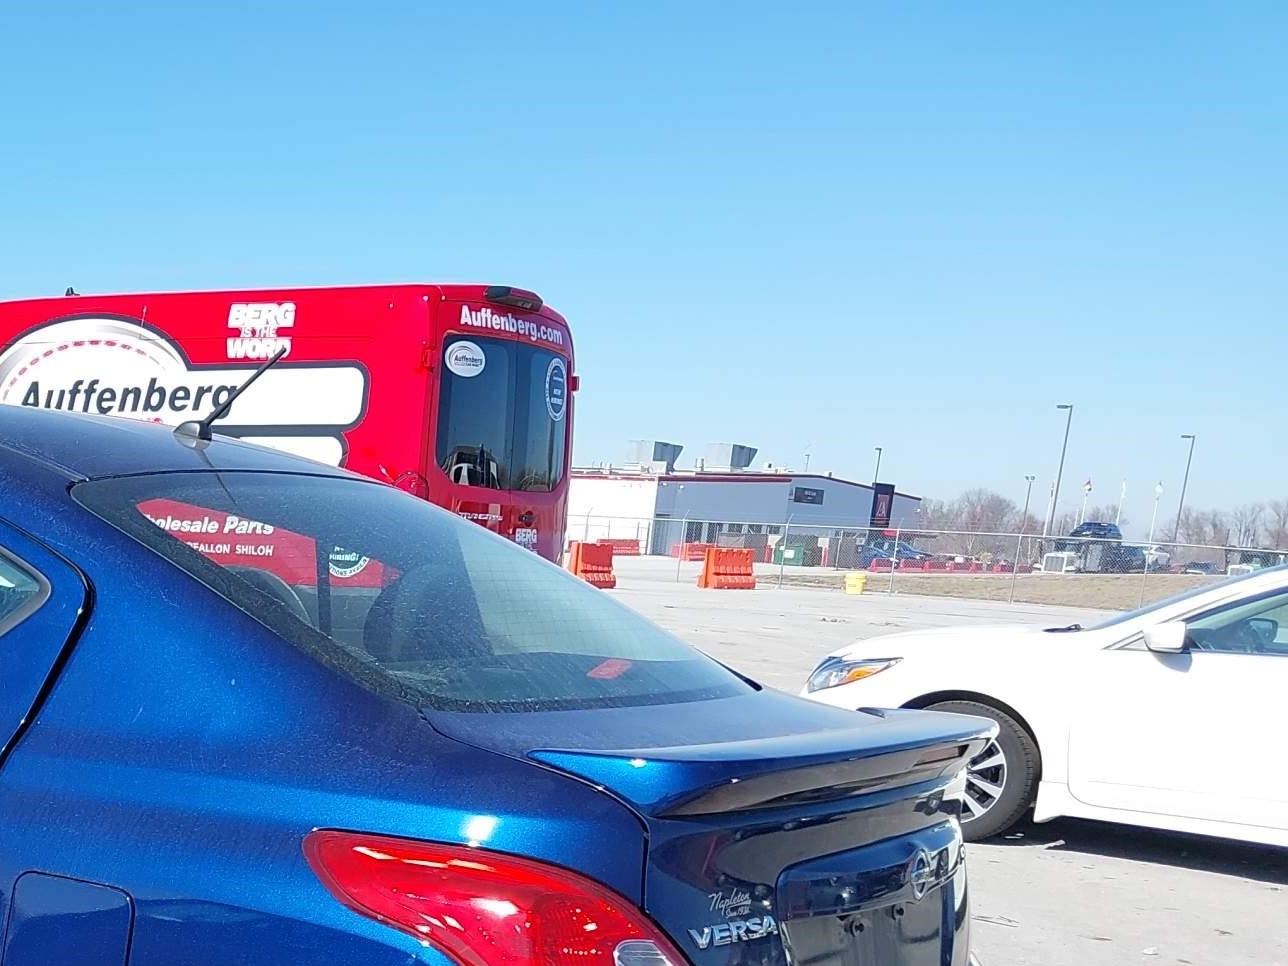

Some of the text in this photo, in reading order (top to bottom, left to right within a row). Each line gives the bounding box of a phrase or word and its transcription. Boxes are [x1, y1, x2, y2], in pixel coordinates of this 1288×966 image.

[228, 303, 296, 328] BERG
[460, 305, 563, 345] Auffenberg.com
[240, 327, 277, 338] IS THE
[227, 337, 292, 359] WORD
[21, 377, 238, 420] Auffenberg
[143, 513, 274, 535] olesale Parts
[515, 528, 538, 544] BERG
[235, 545, 274, 556] SHILOH
[687, 915, 778, 949] VERSA
